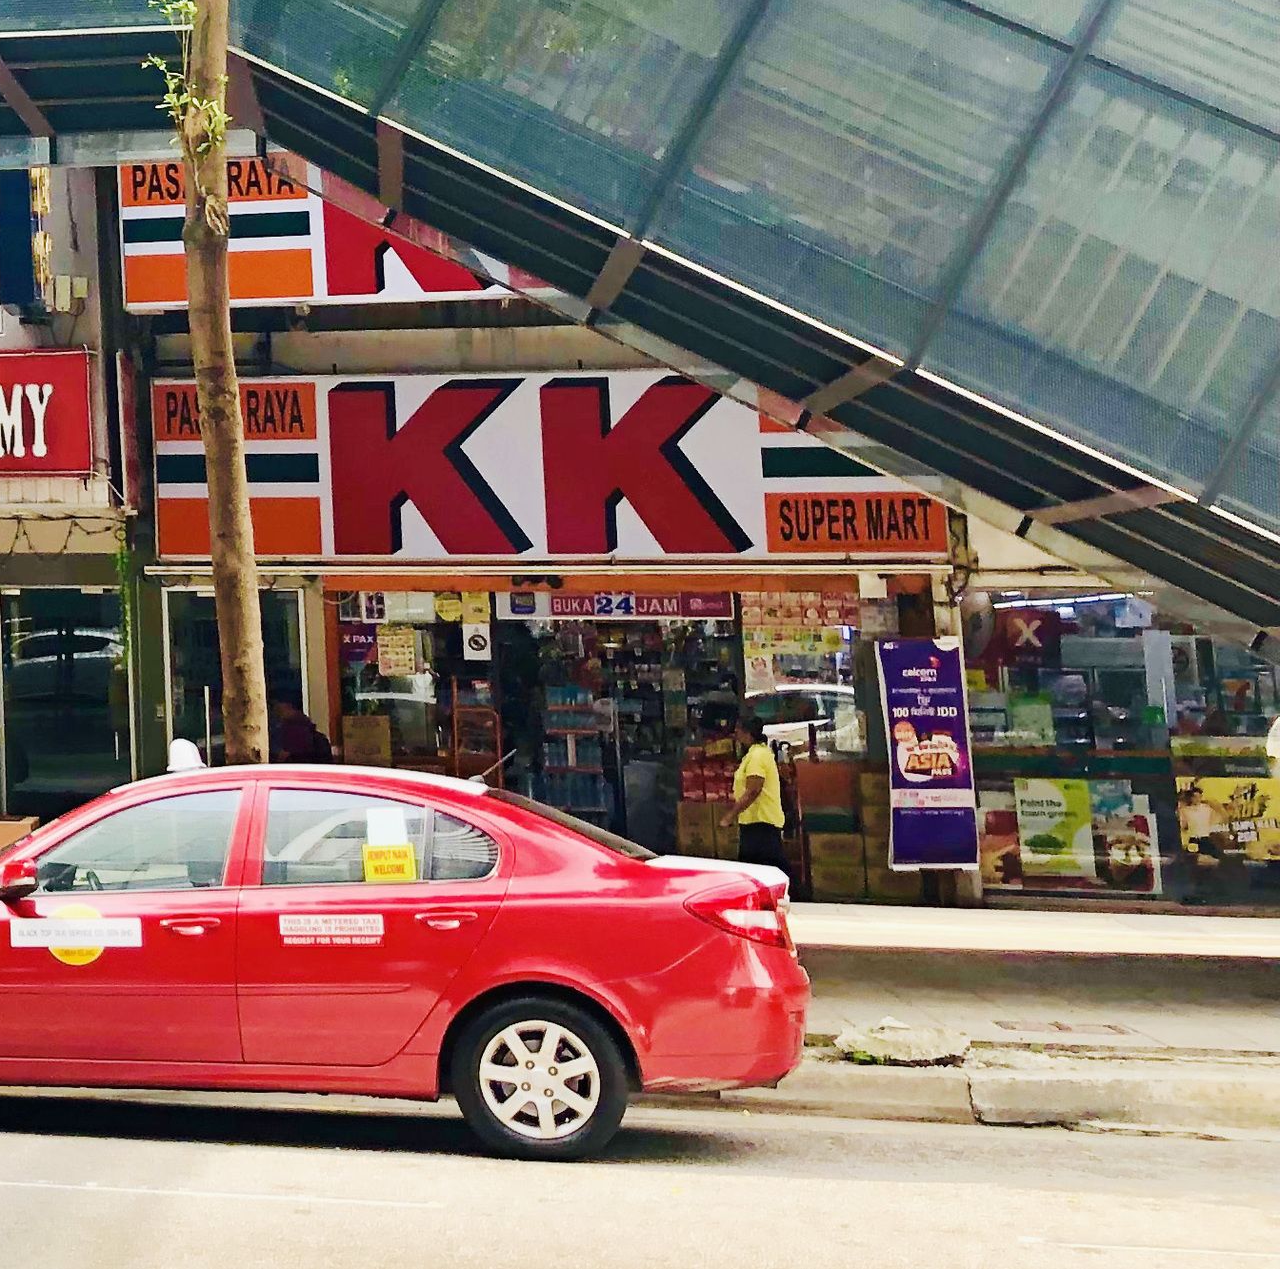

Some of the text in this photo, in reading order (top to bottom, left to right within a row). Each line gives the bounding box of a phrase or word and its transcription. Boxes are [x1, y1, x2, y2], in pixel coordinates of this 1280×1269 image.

[246, 388, 305, 434] RAYA
[328, 376, 753, 556] KK
[778, 497, 933, 542] SUPER MART
[552, 598, 592, 613] BUKA
[595, 595, 634, 615] 24
[638, 597, 678, 613] JAM
[892, 707, 909, 718] 100
[937, 707, 958, 717] IDD
[905, 752, 952, 771] ASIA
[373, 864, 405, 875] WELCOME
